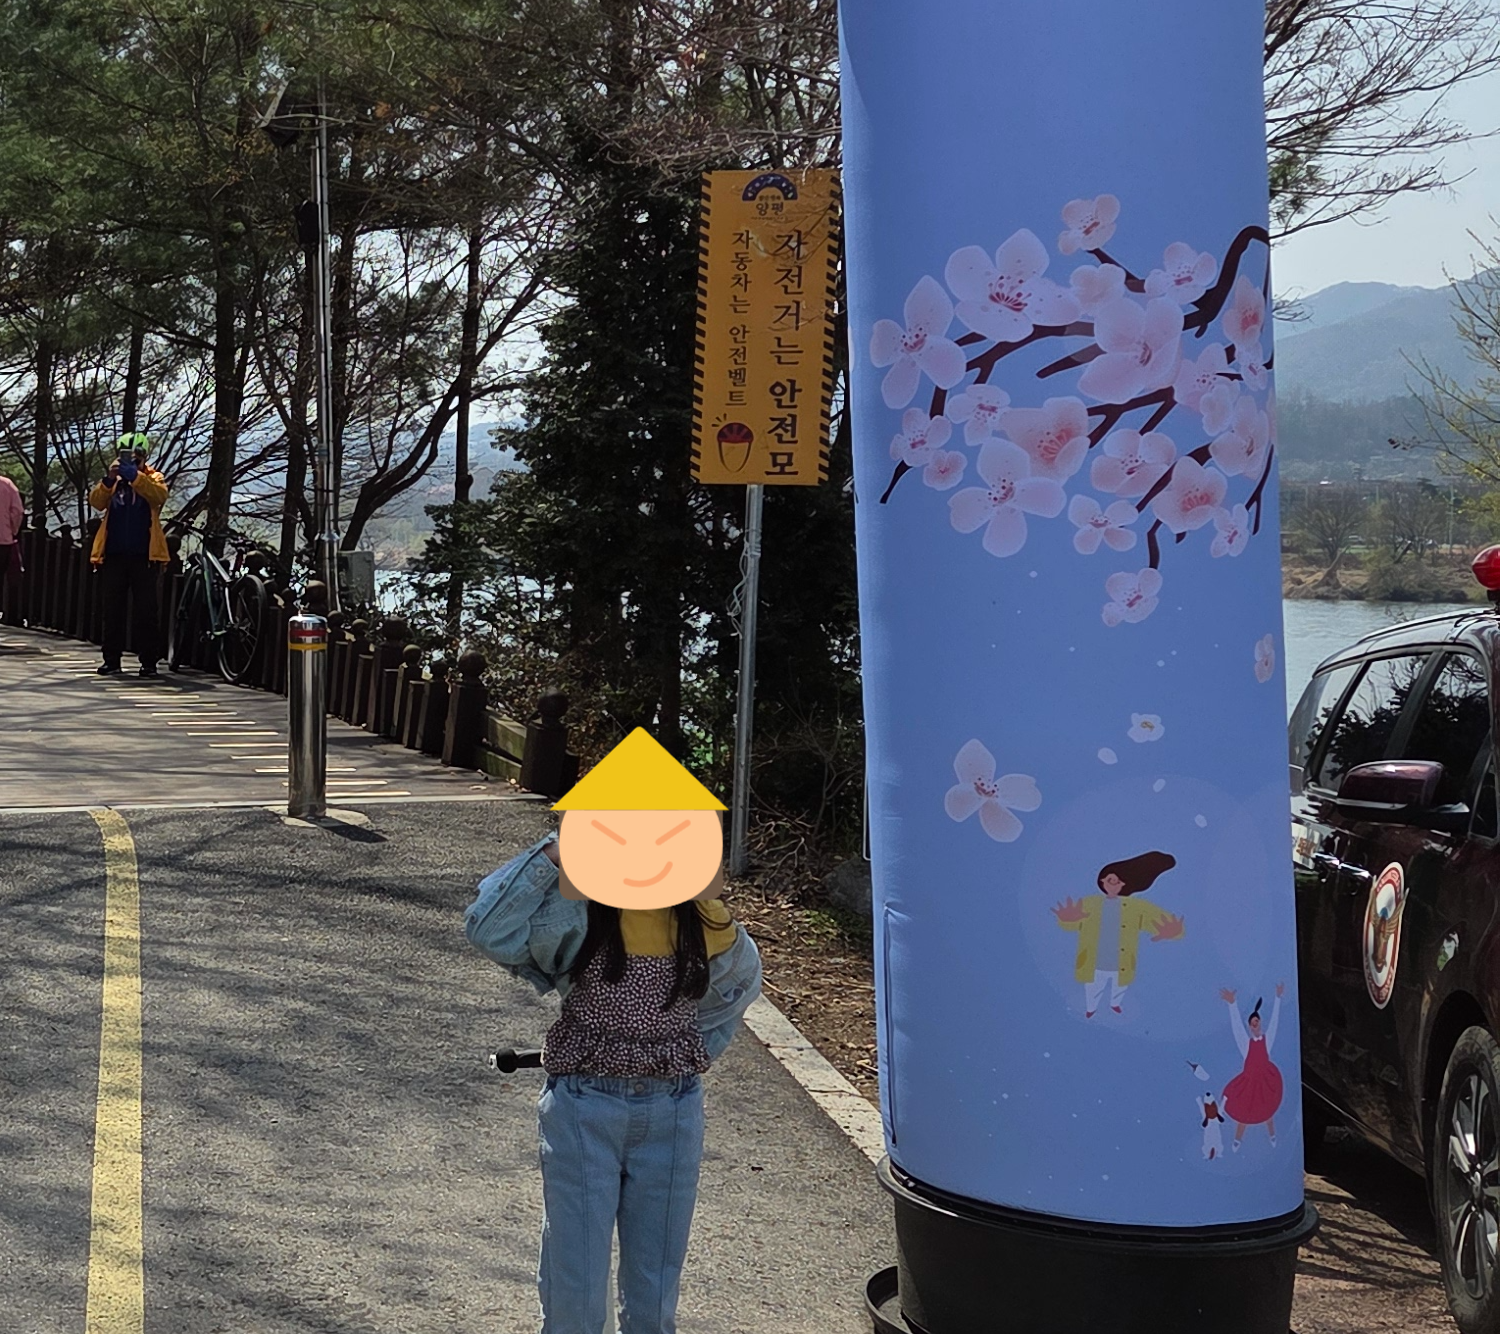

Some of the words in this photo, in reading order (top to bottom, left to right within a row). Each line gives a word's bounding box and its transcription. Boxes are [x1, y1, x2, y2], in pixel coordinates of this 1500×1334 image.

[729, 229, 754, 315] 자동차는
[768, 229, 806, 366] 자전거는
[725, 324, 750, 407] 안전벨트
[764, 378, 803, 476] 안전모
